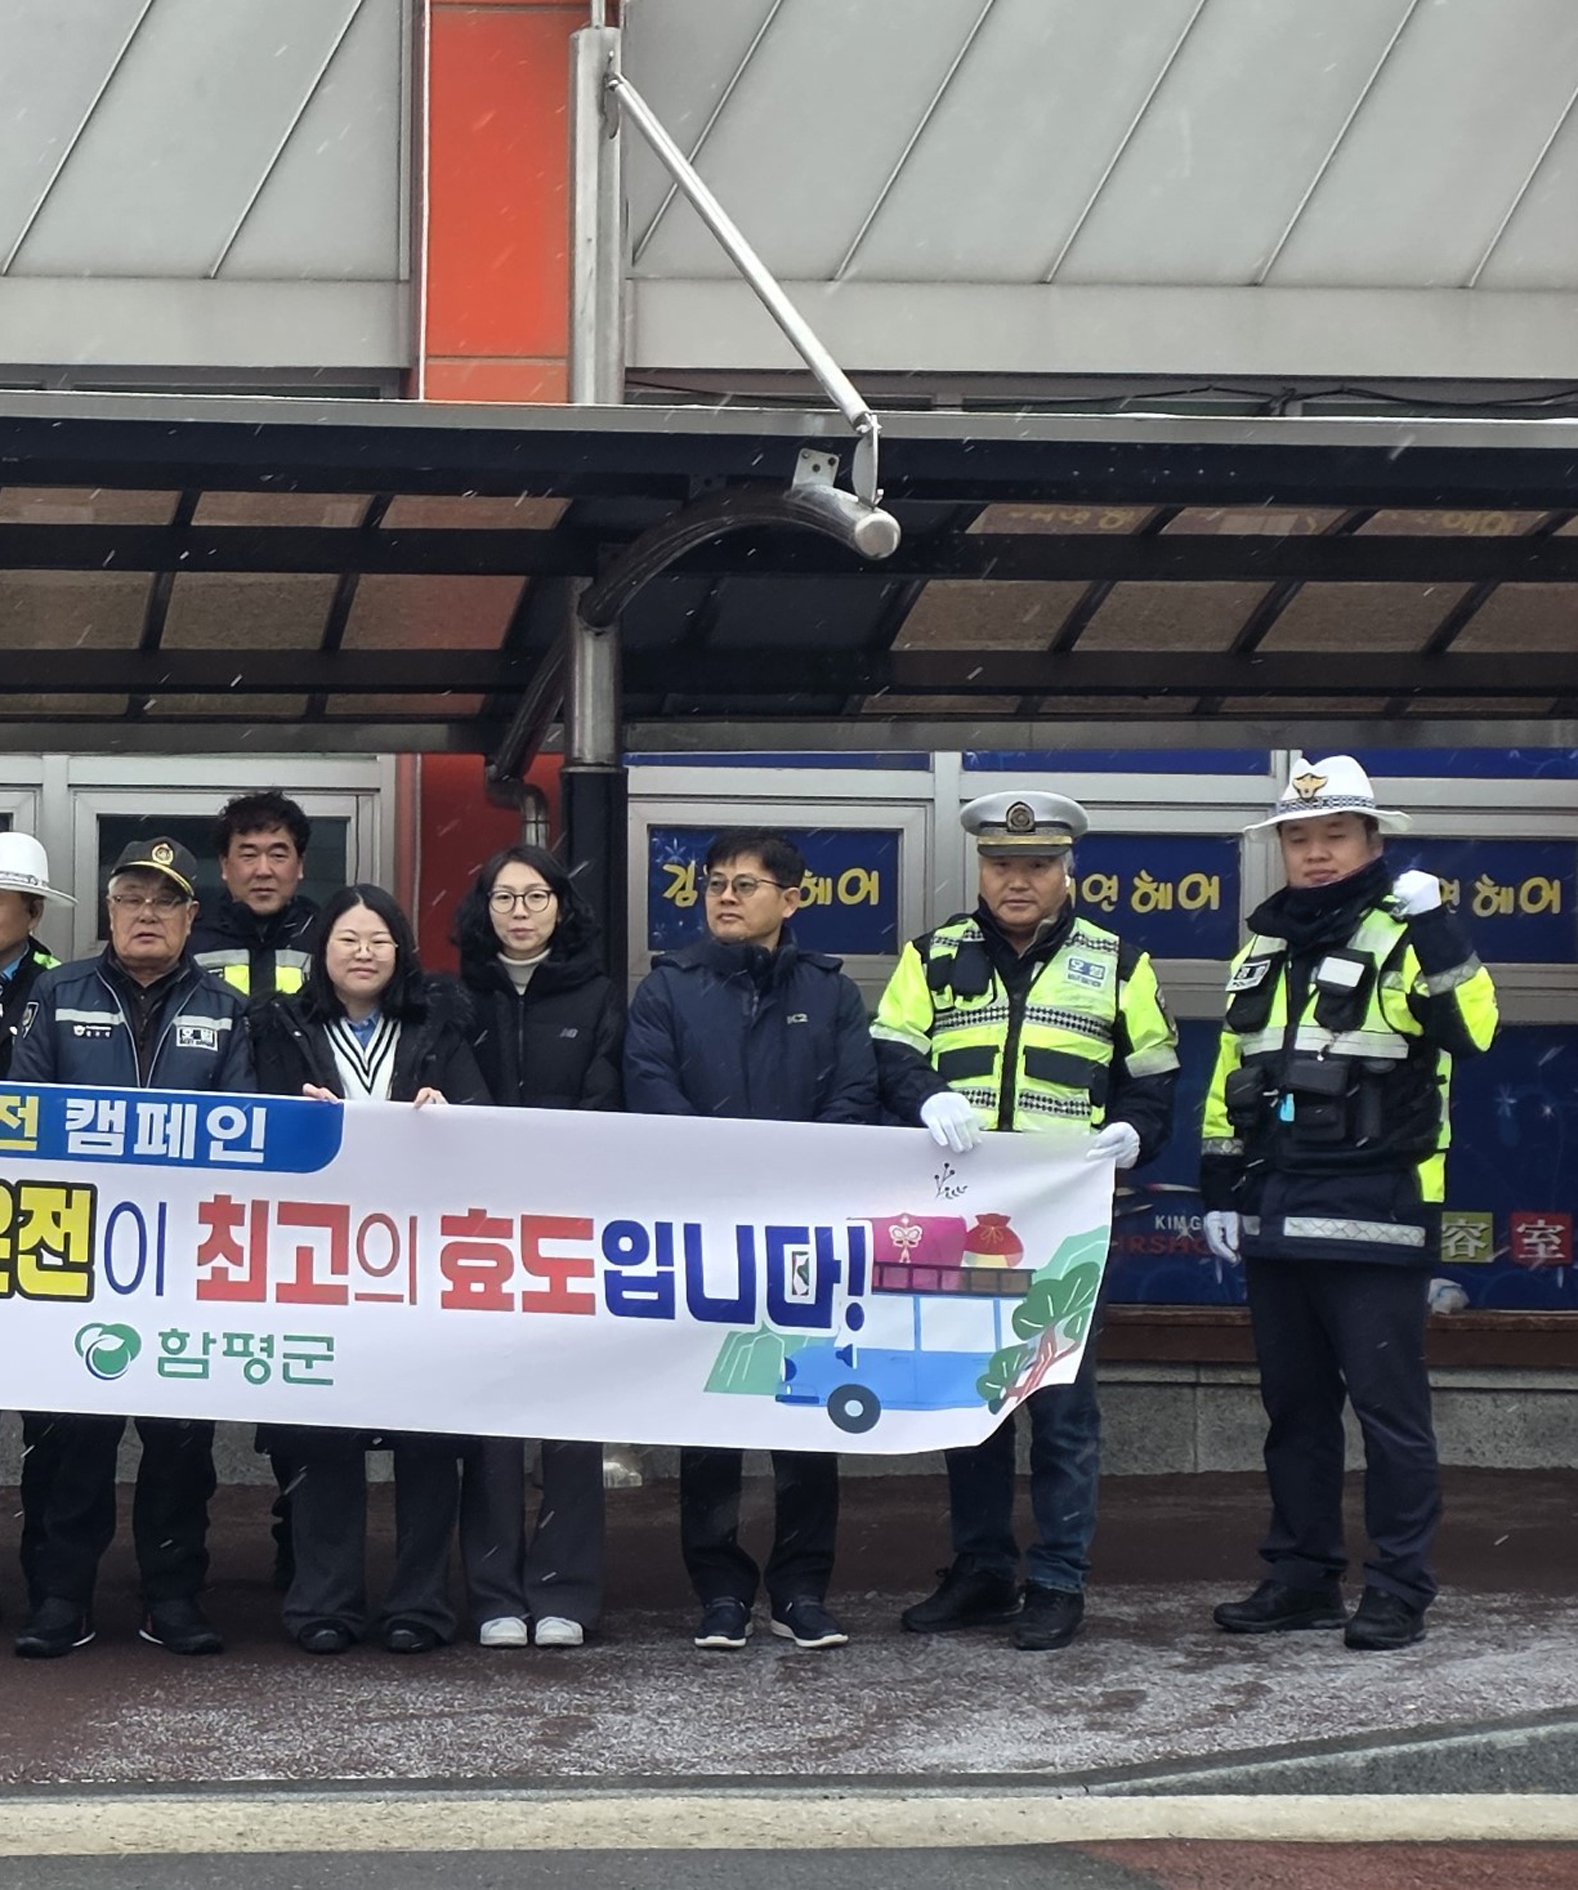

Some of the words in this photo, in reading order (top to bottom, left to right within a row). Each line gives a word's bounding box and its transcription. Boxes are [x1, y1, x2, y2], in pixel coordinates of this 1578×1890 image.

[65, 1098, 268, 1164] 캠페인
[195, 1194, 418, 1307] 최고의
[439, 1207, 867, 1332] 효도입니다!
[157, 1327, 335, 1386] 함평군
